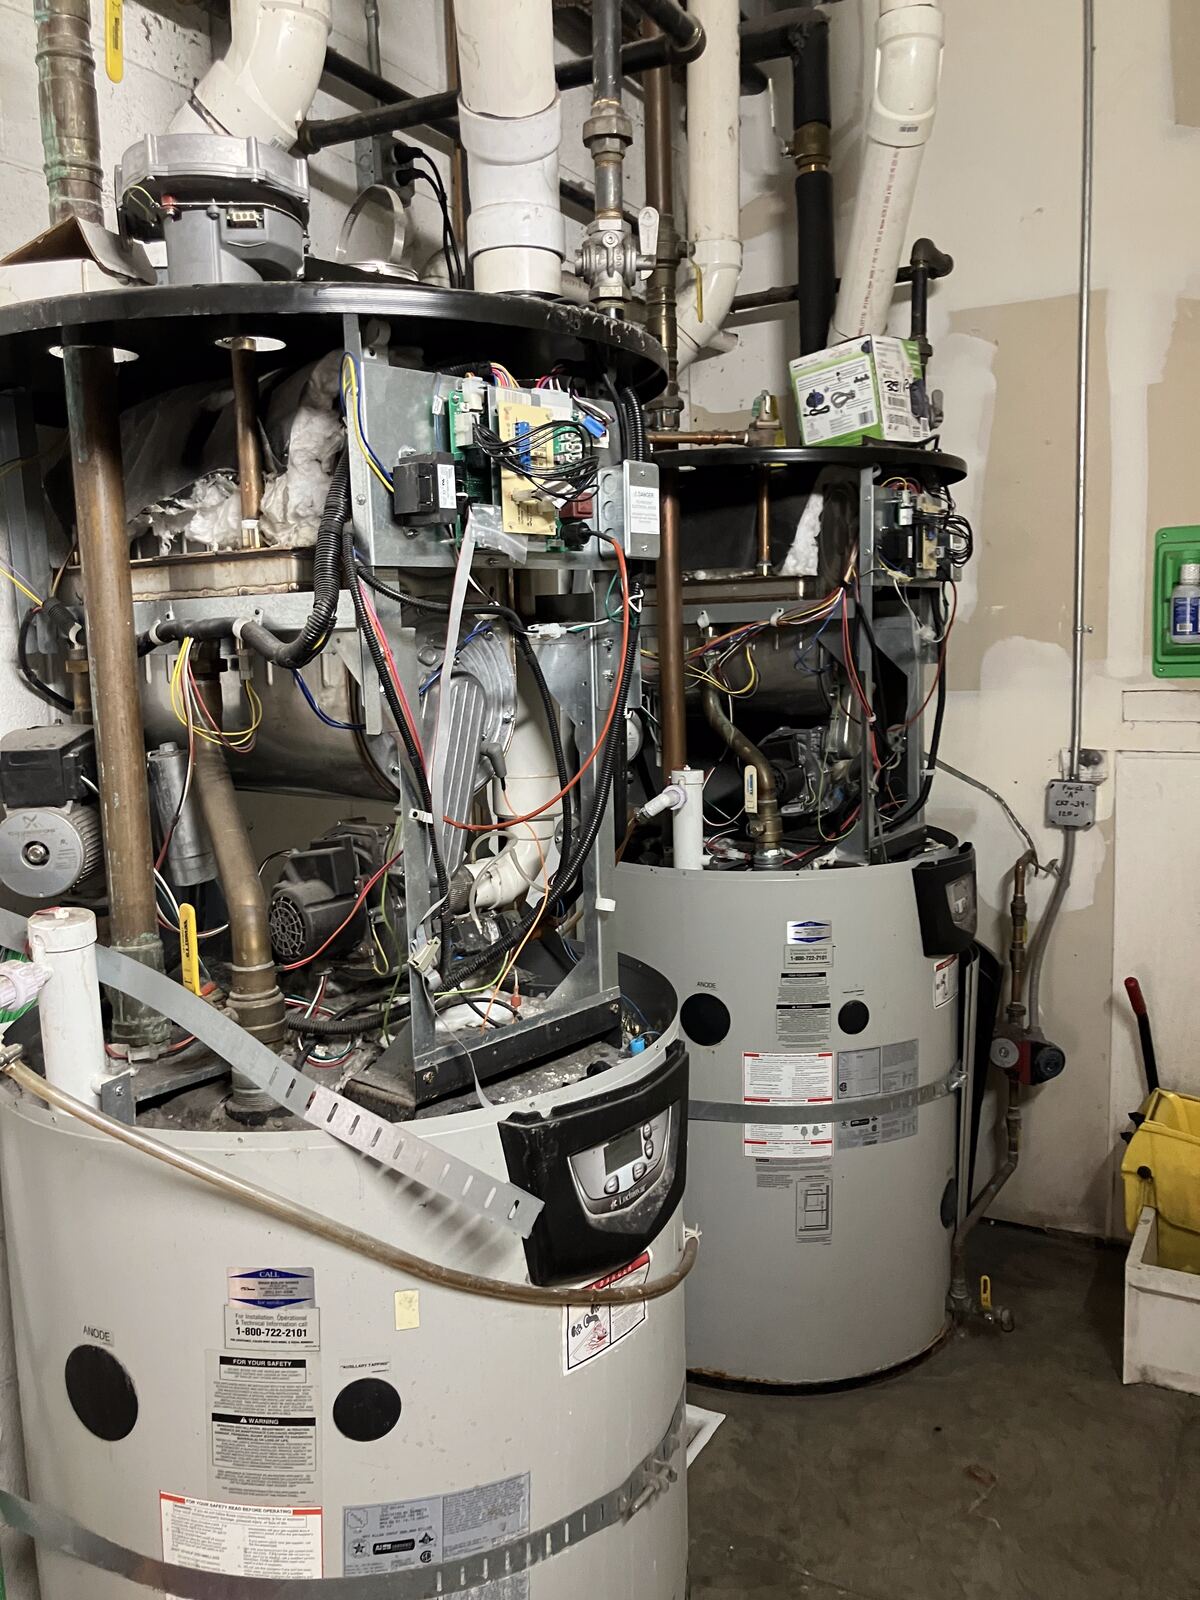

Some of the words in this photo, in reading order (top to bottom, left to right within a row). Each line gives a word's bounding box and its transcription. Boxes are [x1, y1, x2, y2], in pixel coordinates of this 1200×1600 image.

[83, 1324, 111, 1342] ANODE
[235, 1327, 307, 1337] 1-800-722-2101
[248, 1417, 279, 1425] WARNING
[209, 1502, 228, 1510] SAFETY
